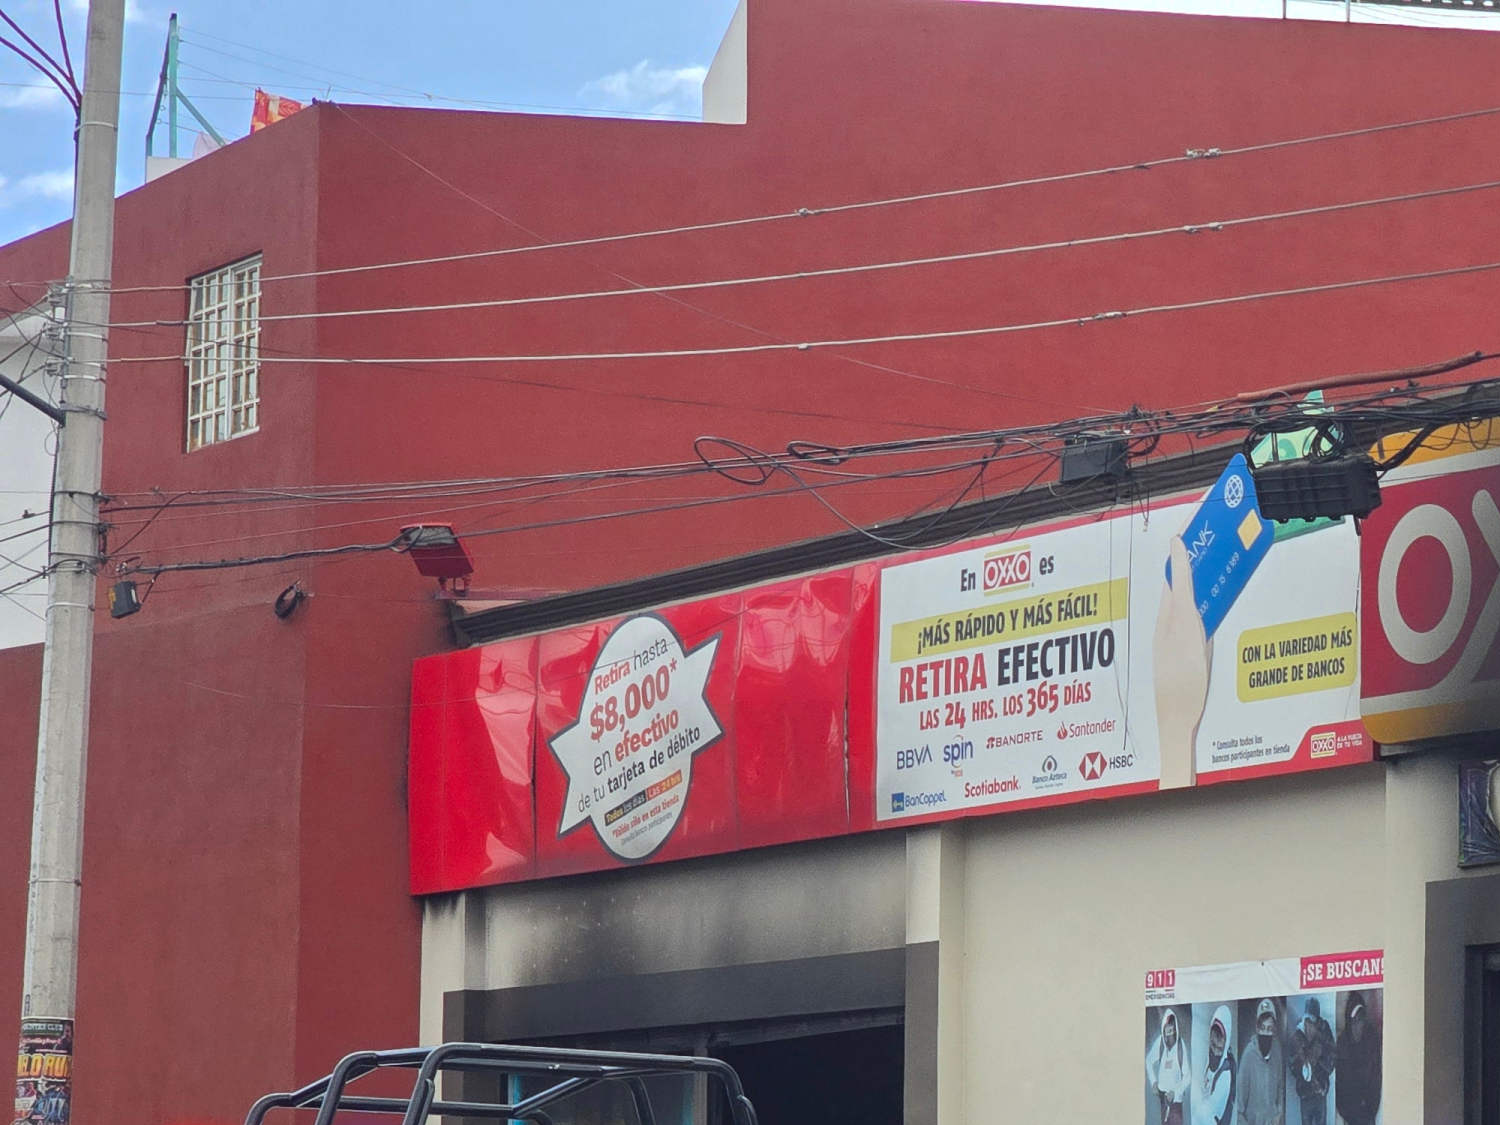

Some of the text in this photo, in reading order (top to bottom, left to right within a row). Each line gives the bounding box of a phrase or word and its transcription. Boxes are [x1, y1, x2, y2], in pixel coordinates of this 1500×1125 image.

[1187, 520, 1216, 562] ANK
[961, 552, 1054, 592] En OXXO es
[918, 592, 1098, 654] ¡MÁS RÁPIDO Y MÁS FÁCIL!
[1242, 626, 1352, 663] CON LA VARIEDAD MÁS
[594, 638, 668, 694] Retira hasta
[899, 628, 1115, 704] RETIRA EFECTIVO
[1249, 657, 1345, 688] GRANDE DE BANCOS
[920, 679, 1092, 730] LAS 24 HRS. LOS 365 DÍAS
[594, 709, 679, 775] en efectivo
[995, 730, 1043, 748] BANORTE
[1069, 718, 1116, 738] Santander
[897, 744, 932, 770] BBVA
[943, 740, 974, 765] spin
[1312, 738, 1335, 753] OXXO
[578, 727, 700, 812] de tu tarjeta de débito
[1109, 754, 1133, 769] HSBC
[905, 789, 947, 808] BanCoppel
[964, 776, 1020, 798] Scotiabank
[1147, 971, 1174, 987] 911
[1303, 957, 1384, 985] ¡SE BUSCAN!
